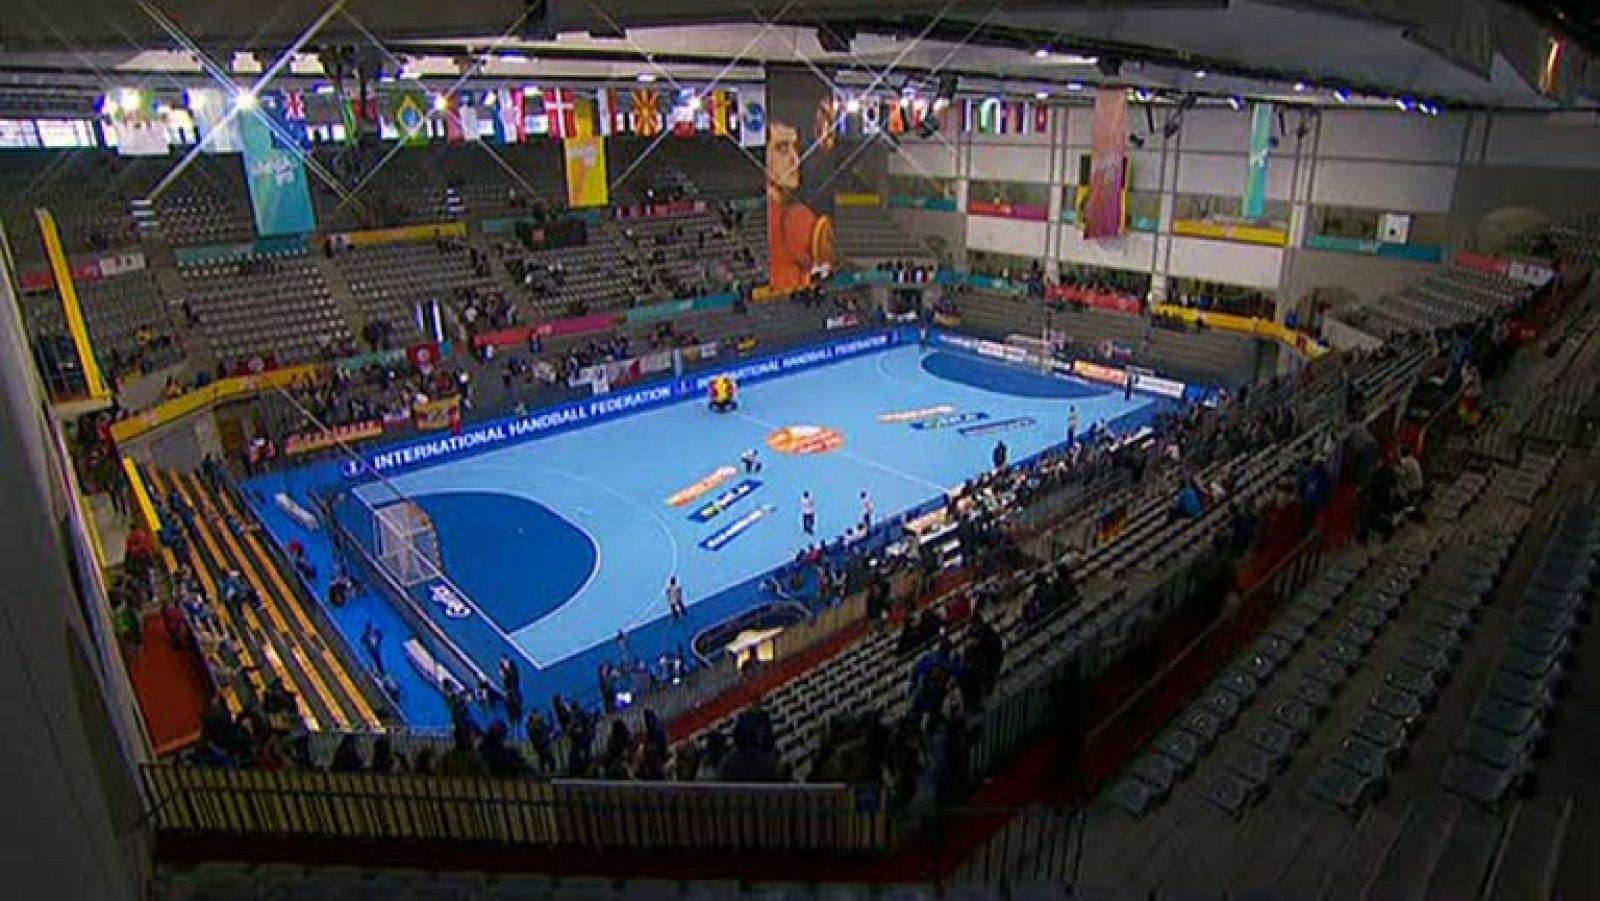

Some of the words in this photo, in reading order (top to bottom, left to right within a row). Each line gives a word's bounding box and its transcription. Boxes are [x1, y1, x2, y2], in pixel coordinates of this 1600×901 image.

[835, 335, 889, 357] FEDERATION
[374, 425, 507, 470] INTERNATIONAL
[509, 405, 588, 437] HANDBALL
[591, 386, 671, 416] FEDERATION
